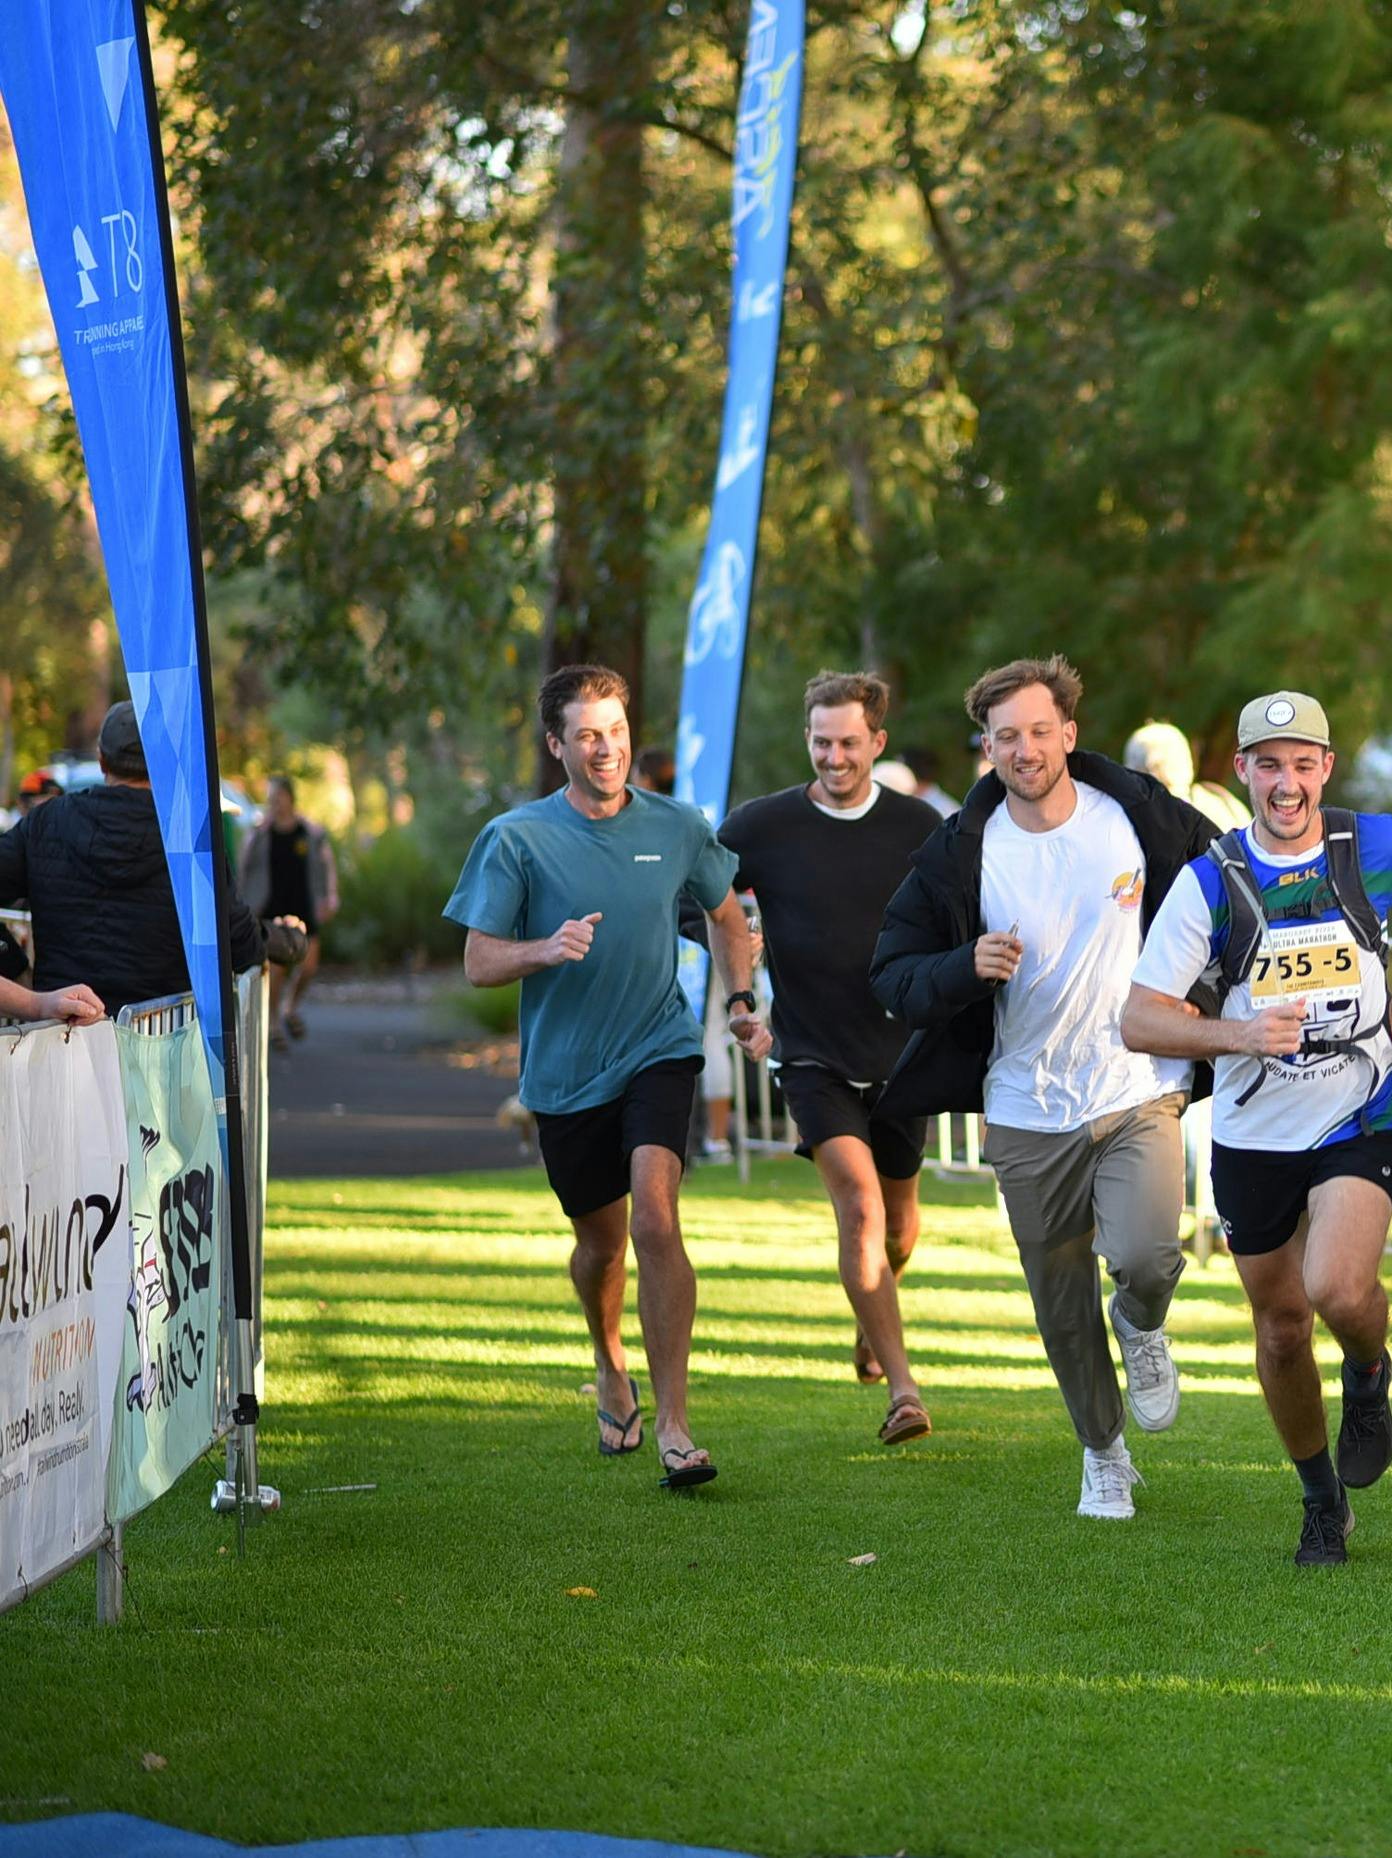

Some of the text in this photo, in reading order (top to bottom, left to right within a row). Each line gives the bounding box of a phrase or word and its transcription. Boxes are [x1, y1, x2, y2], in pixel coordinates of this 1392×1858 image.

[101, 209, 143, 298] T8
[1279, 867, 1319, 886] BLK
[1273, 933, 1337, 949] ULTRA MARATHON
[1302, 1071, 1317, 1081] ET
[32, 1317, 96, 1387] NUTRITION
